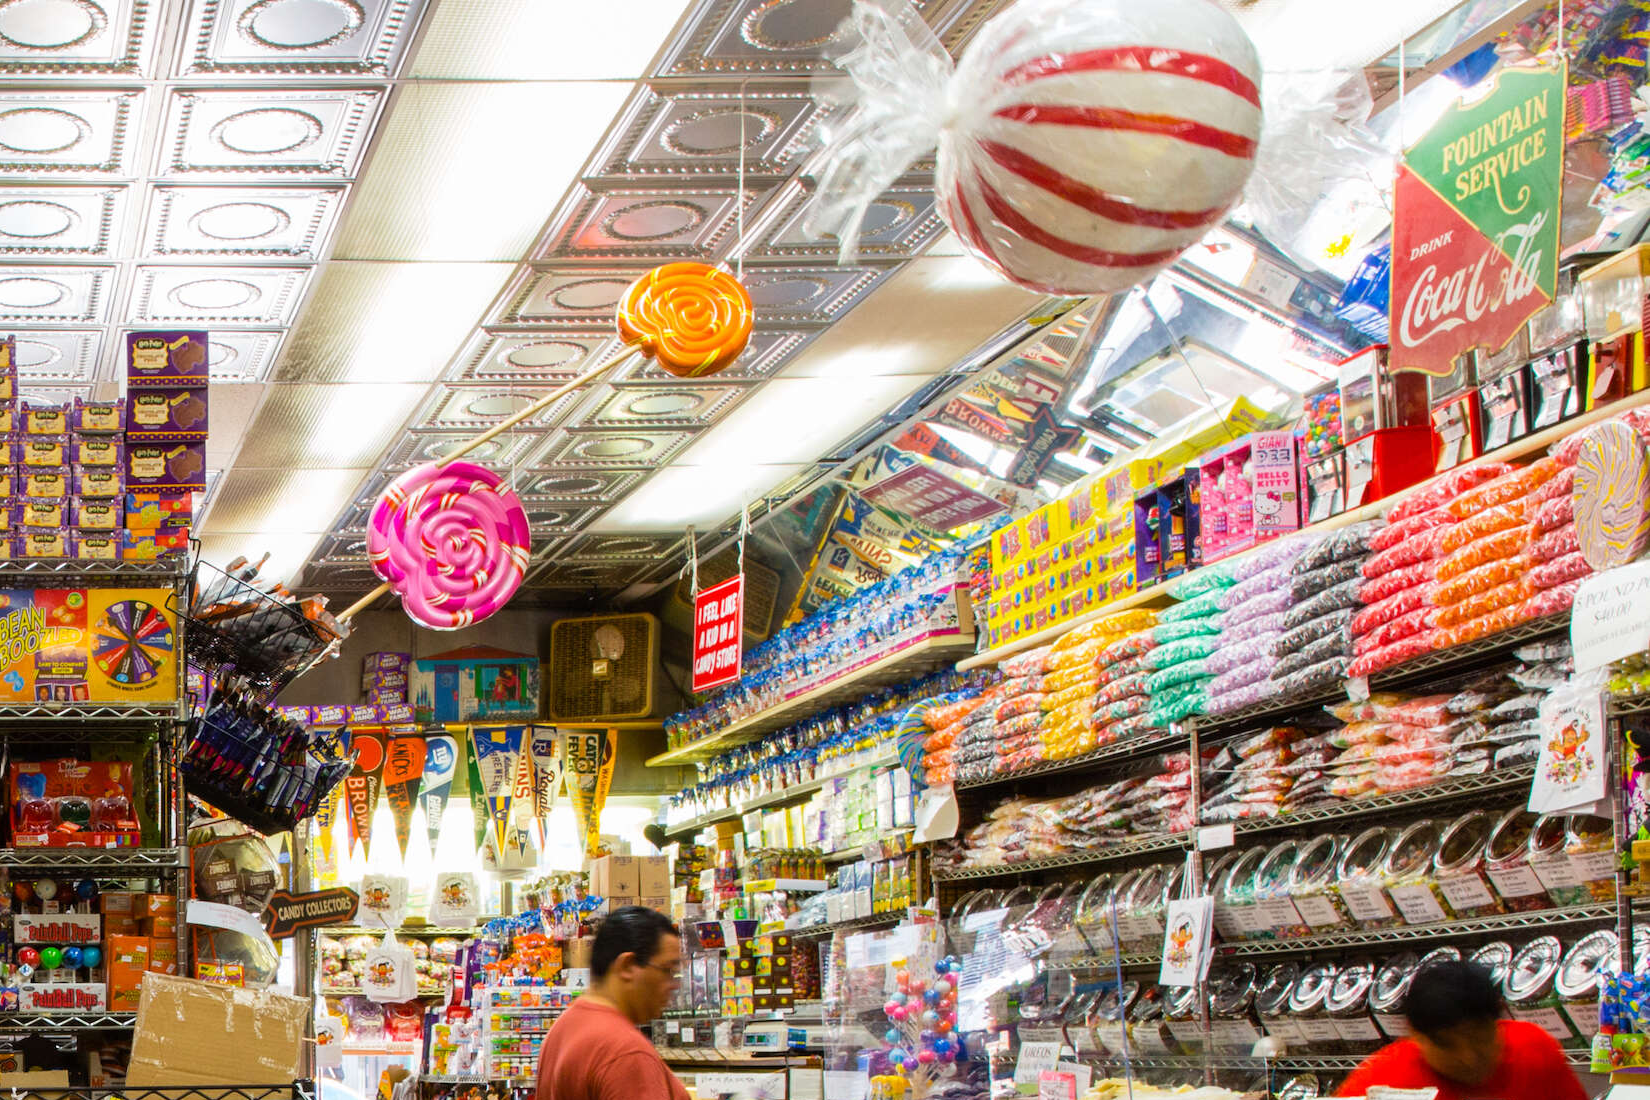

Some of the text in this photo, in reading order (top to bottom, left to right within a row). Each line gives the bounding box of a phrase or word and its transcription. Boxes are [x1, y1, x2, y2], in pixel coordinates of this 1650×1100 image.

[1442, 89, 1549, 176] FOUNTAIN
[1455, 128, 1547, 205] SERVICE
[1410, 231, 1454, 262] DRINK
[1399, 208, 1549, 348] Coca-Cola
[1257, 471, 1289, 479] HELLO
[698, 592, 737, 626] I FEEL LIKE
[699, 620, 734, 650] A KID IN A
[695, 644, 737, 675] CANDY STORE
[391, 743, 408, 776] KNICKS
[568, 735, 579, 773] FEVER
[348, 776, 370, 843] BROWNS
[532, 768, 555, 818] Royals
[278, 896, 352, 921] CANDY COLLECTORS
